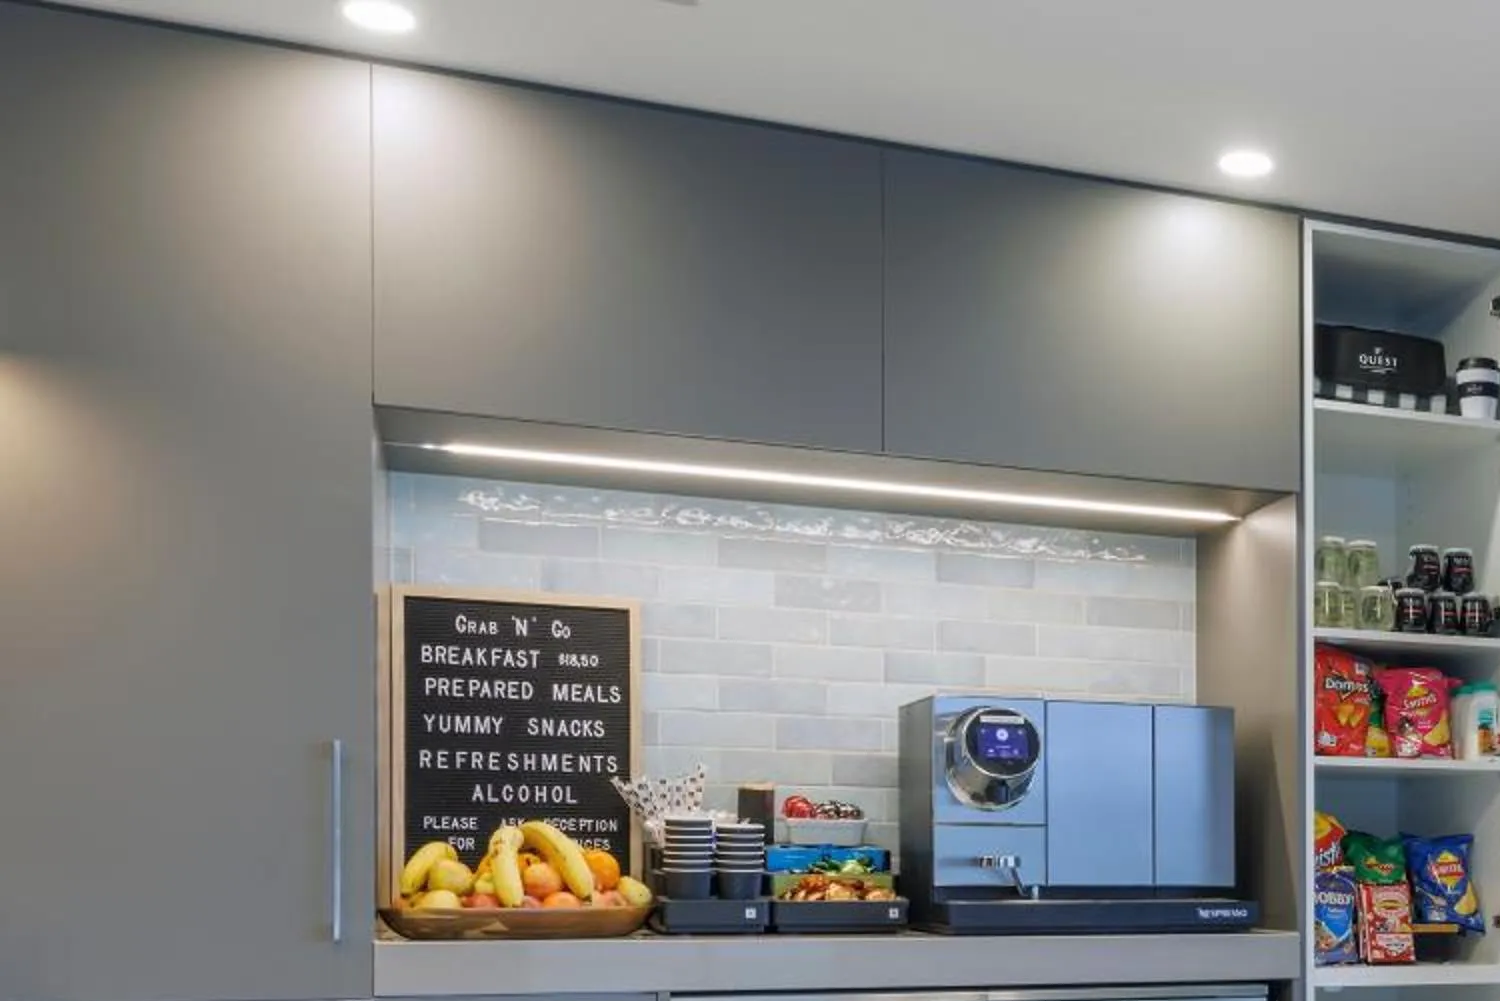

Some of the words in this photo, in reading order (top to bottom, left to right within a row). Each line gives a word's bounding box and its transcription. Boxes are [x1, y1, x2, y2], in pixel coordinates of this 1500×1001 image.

[1359, 353, 1398, 367] QUEST
[421, 645, 541, 669] BREAKFAST
[425, 677, 534, 700] PREPARED
[552, 683, 622, 703] MEALS
[423, 713, 504, 735] YUMMY
[527, 718, 605, 738] SNACKS
[419, 749, 619, 774] REFRESHMENTS
[471, 784, 578, 804] ALCOHOL
[423, 815, 479, 830] PLEASE
[447, 836, 475, 851] FOR
